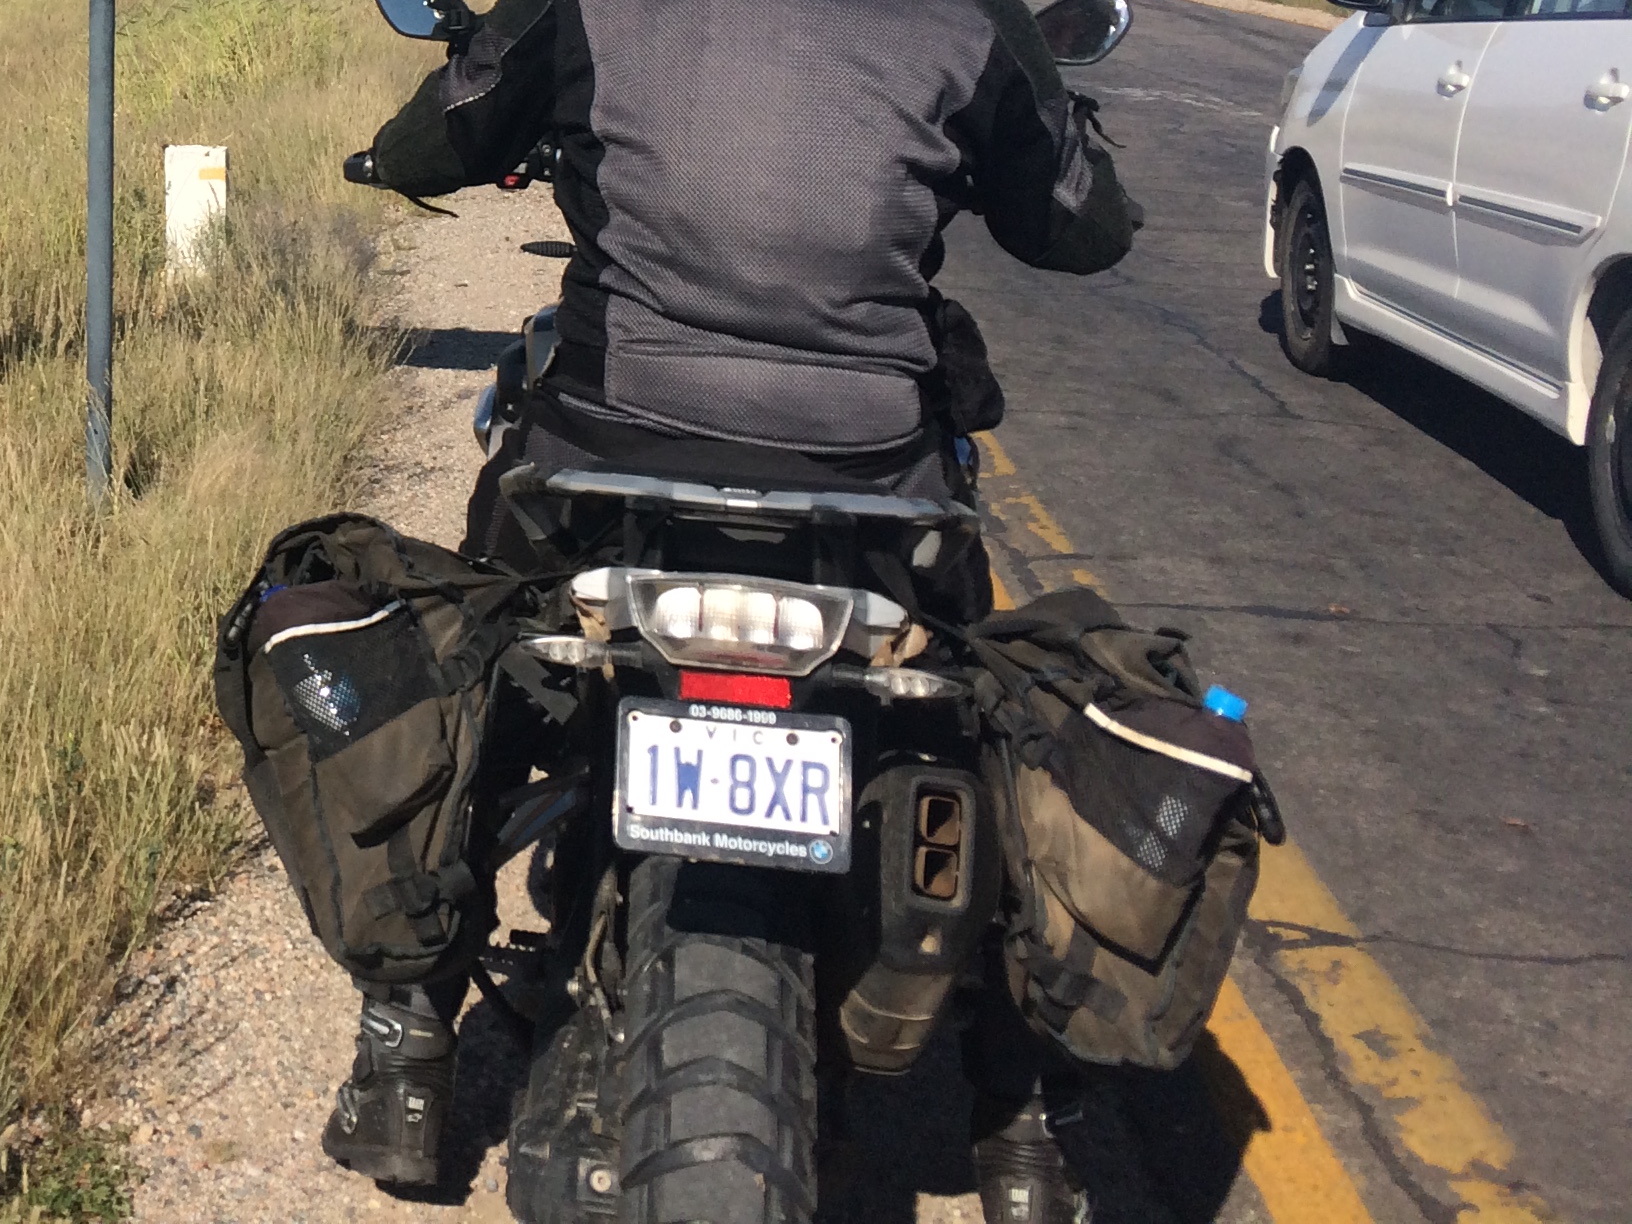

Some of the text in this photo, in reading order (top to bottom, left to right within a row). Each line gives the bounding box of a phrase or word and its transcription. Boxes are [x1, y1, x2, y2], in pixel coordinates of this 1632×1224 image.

[706, 725, 763, 745] VIC
[627, 824, 711, 848] Southbank
[714, 832, 808, 859] Motorcycles
